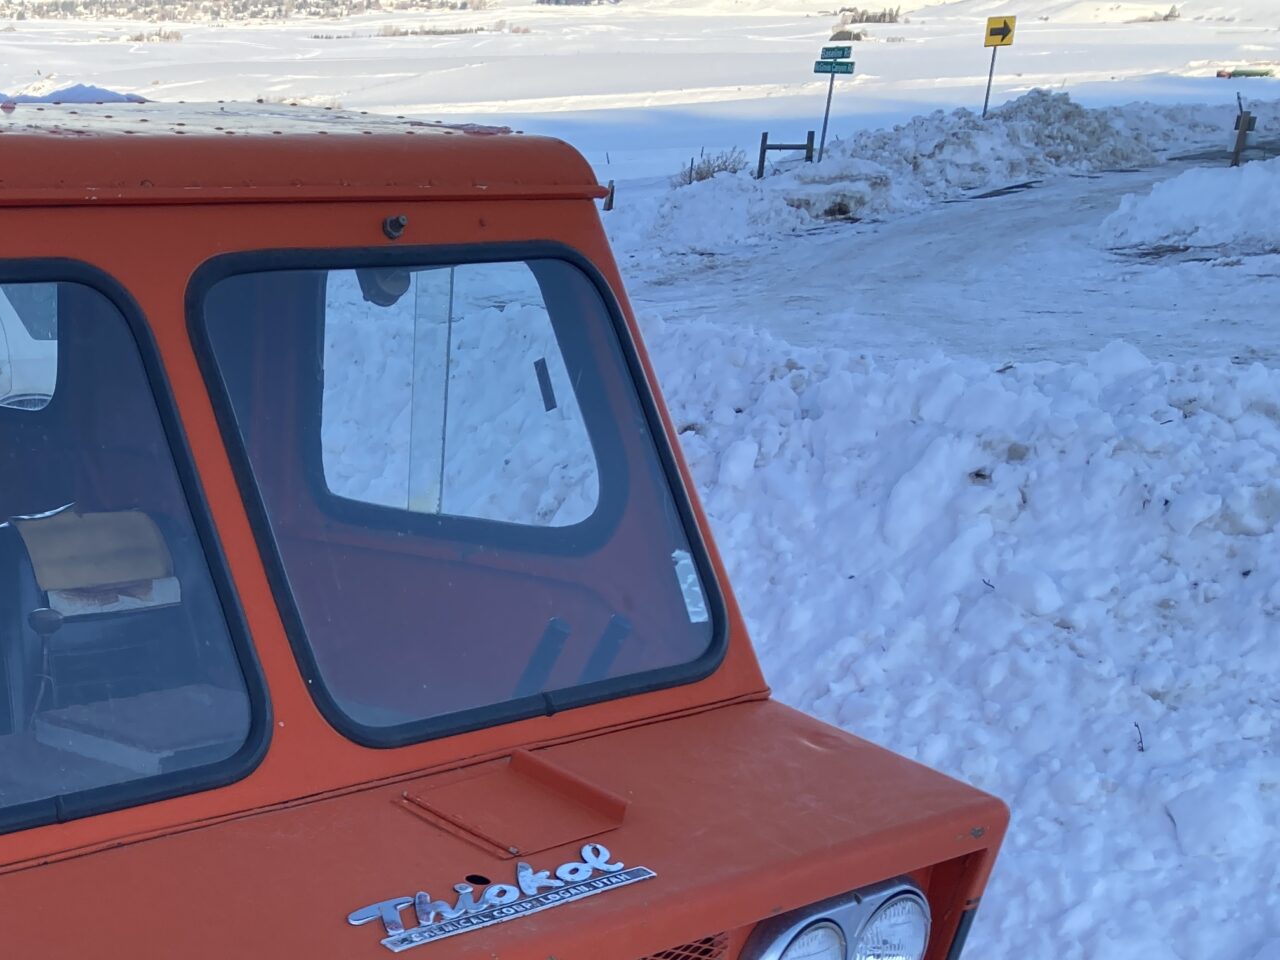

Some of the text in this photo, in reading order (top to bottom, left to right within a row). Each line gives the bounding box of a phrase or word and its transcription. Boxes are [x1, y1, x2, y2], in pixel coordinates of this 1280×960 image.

[348, 843, 624, 936] Thiokol
[411, 914, 490, 942] CHEMICAL
[591, 873, 631, 888] UTAH
